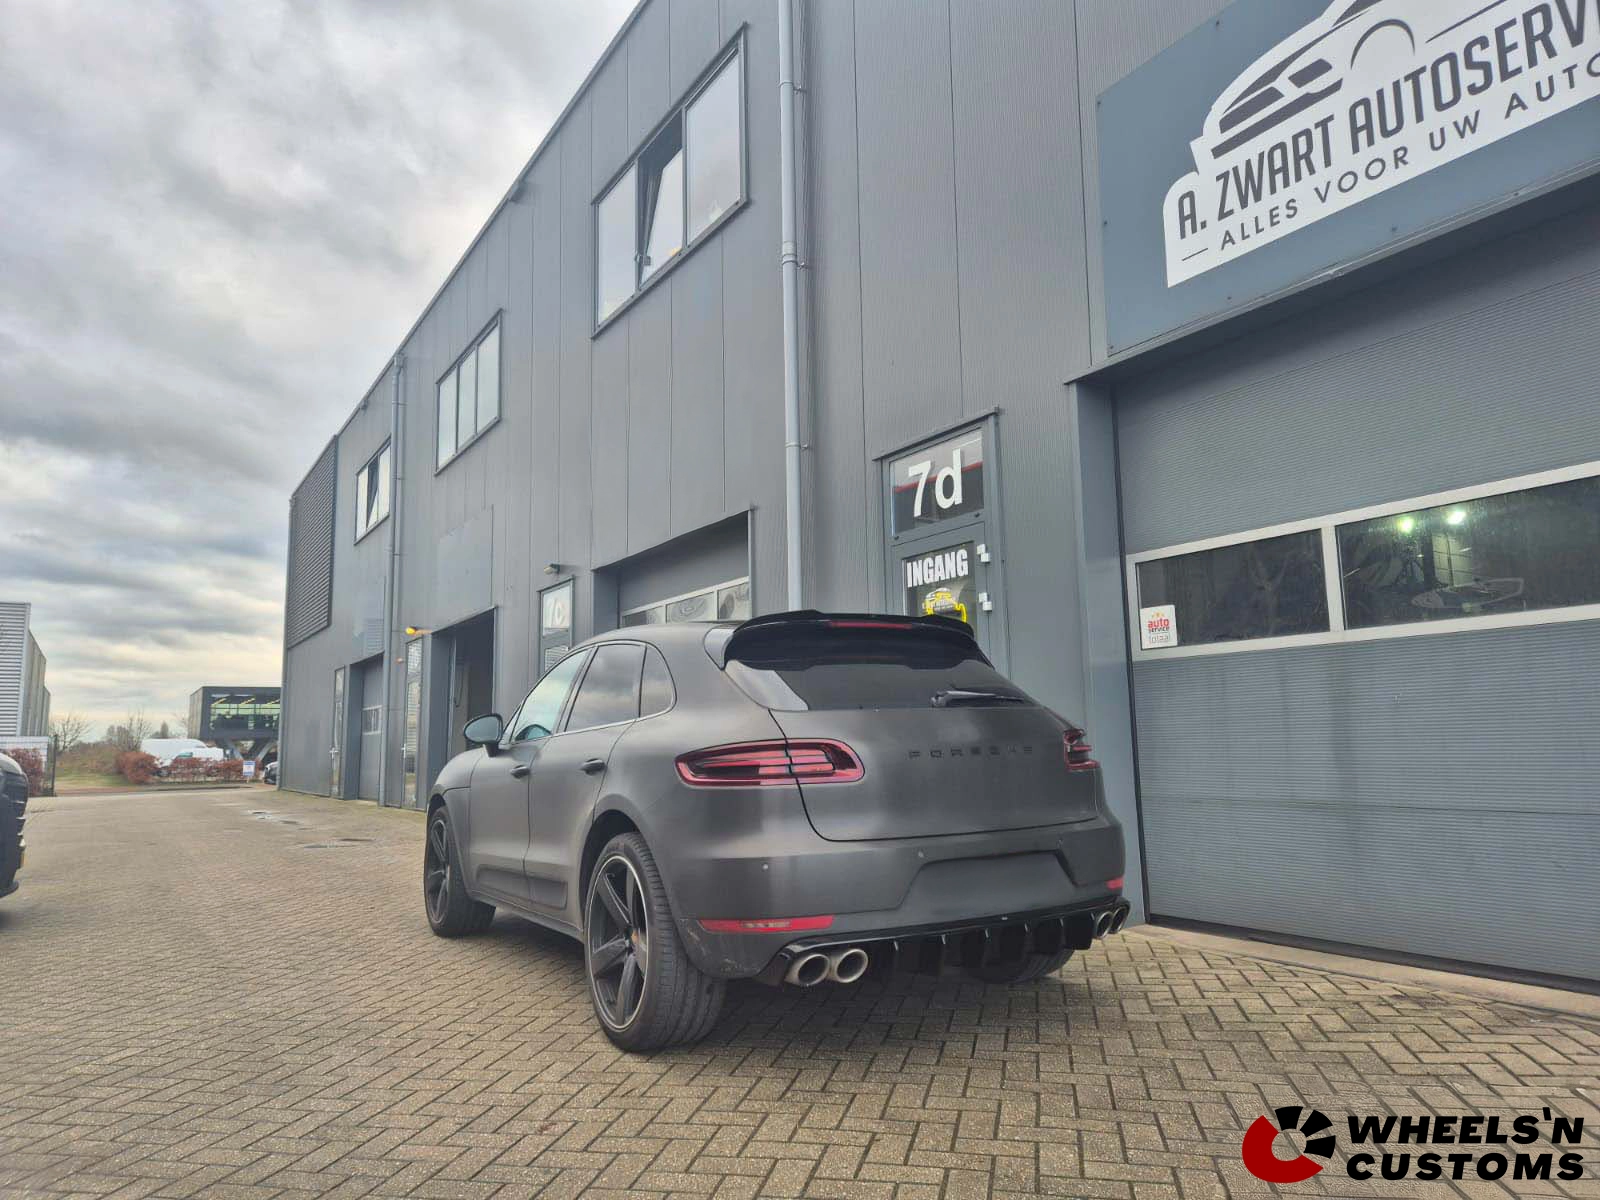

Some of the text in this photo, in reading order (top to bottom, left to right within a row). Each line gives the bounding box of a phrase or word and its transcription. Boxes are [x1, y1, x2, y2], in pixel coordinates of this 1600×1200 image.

[1177, 0, 1600, 240] A. ZWART AUTOSERV
[1221, 198, 1299, 250] ALLES
[1314, 146, 1409, 204] VOOR
[1429, 110, 1481, 152] UW
[908, 448, 963, 517] 7d
[906, 549, 969, 588] INGANG
[1147, 618, 1170, 629] auto
